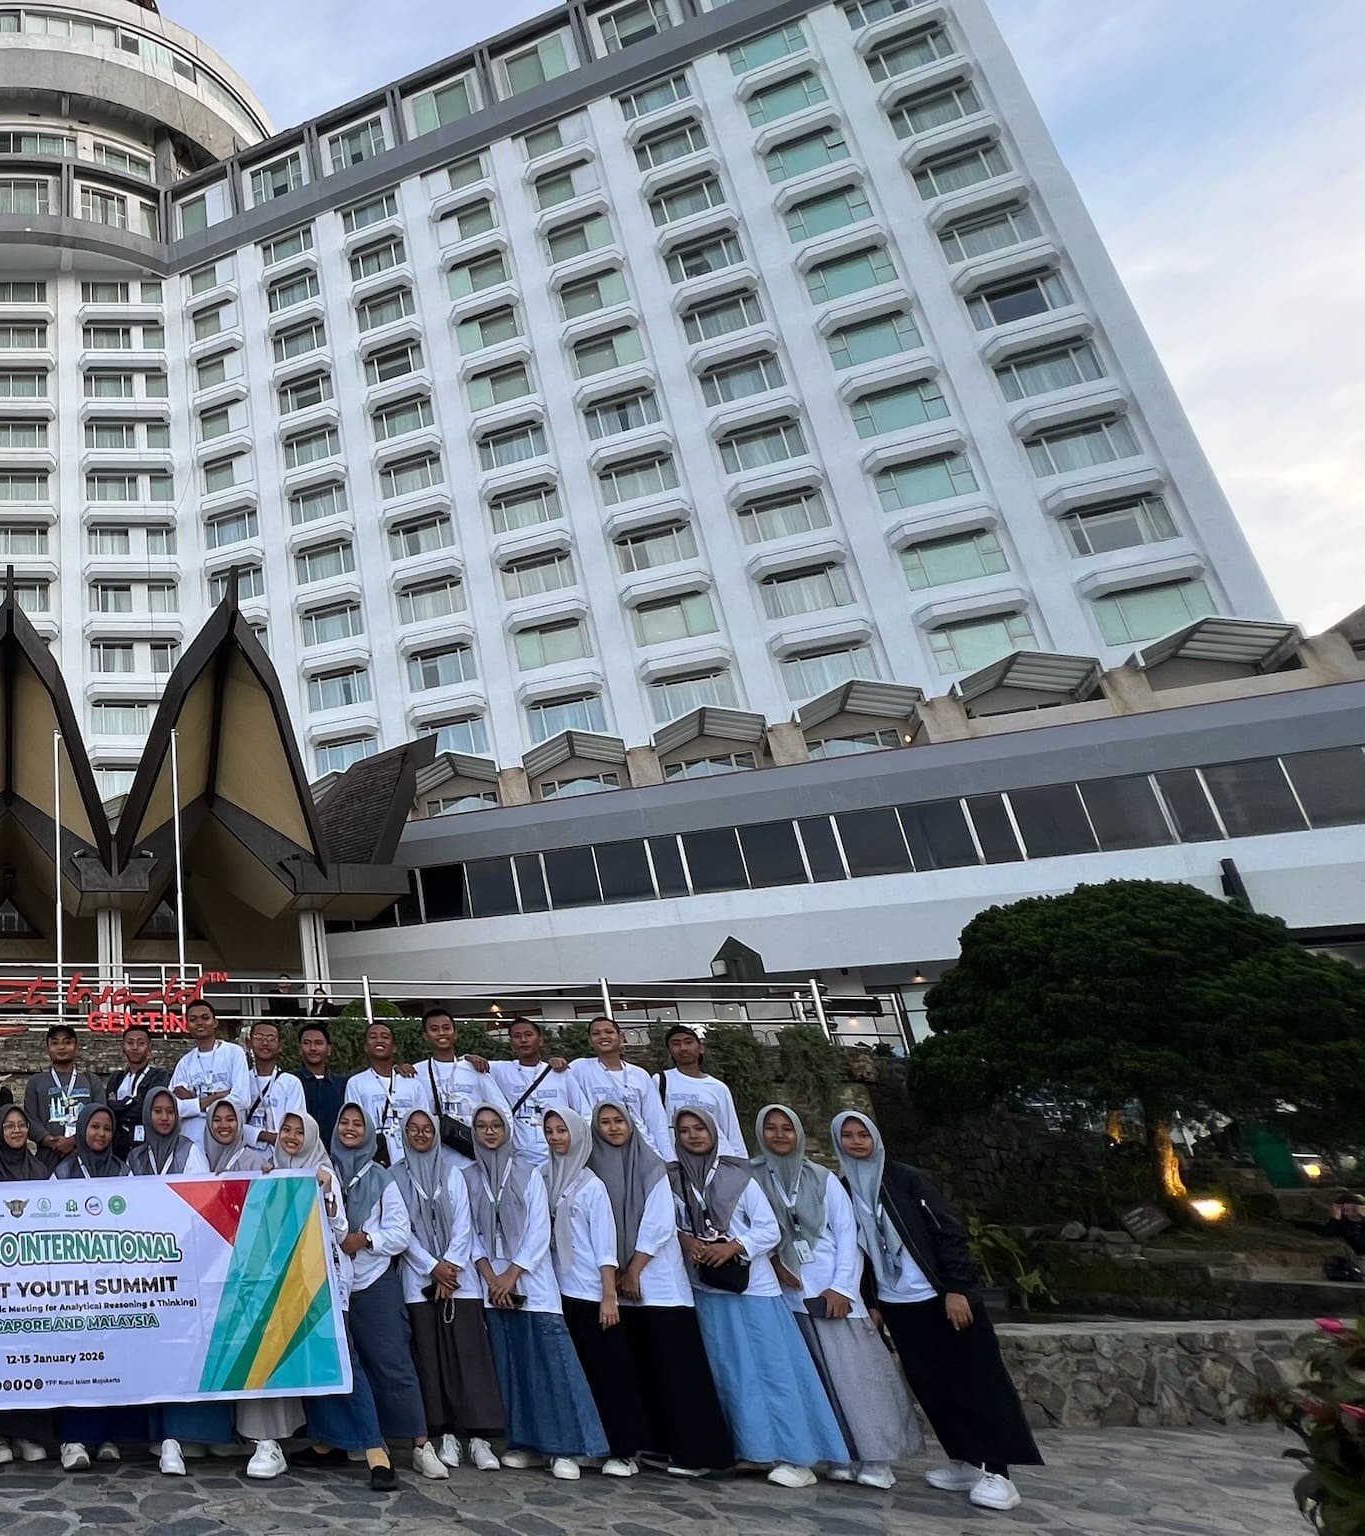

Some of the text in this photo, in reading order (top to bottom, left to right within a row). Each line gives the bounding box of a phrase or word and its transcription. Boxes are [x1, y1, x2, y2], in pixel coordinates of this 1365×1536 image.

[87, 1011, 188, 1033] GENTIN
[20, 1231, 180, 1263] INTERNATIONAL
[16, 1279, 89, 1298] YOUTH
[95, 1276, 178, 1295] SUMMIT
[9, 1303, 43, 1314] Meeting
[45, 1303, 57, 1312] for
[60, 1301, 102, 1312] Analytical
[104, 1299, 147, 1310] Reasoning
[157, 1297, 197, 1308] Thinking)
[53, 1315, 85, 1332] AND
[86, 1313, 160, 1331] MALAYSIA
[5, 1351, 105, 1364] 12-15 January 2026
